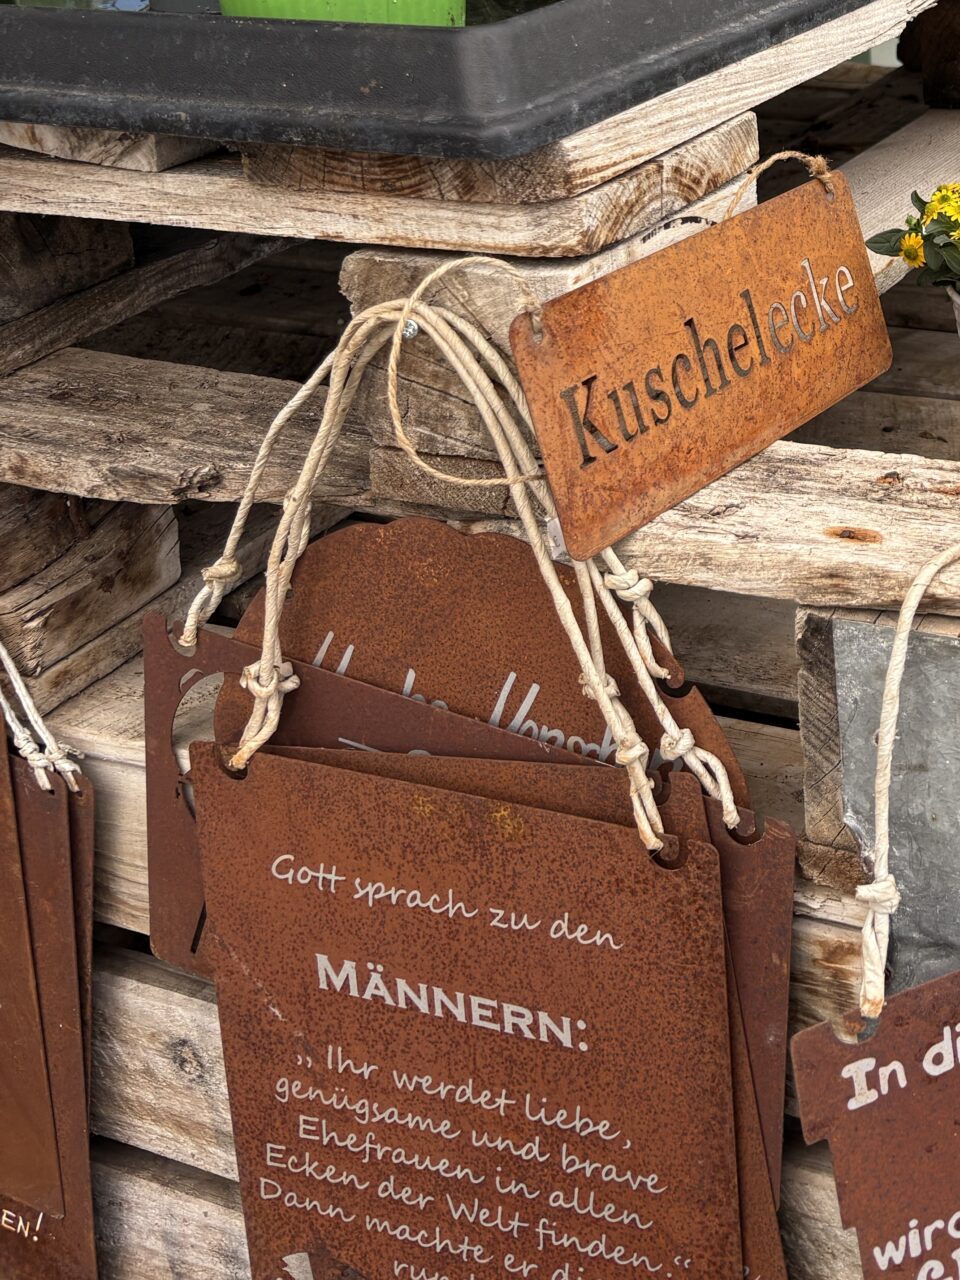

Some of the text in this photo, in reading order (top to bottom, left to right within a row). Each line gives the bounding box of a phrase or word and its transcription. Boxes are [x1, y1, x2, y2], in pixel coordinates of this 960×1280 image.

[560, 257, 860, 470] Kuschelecke
[271, 854, 624, 950] Gott sprach zu den
[315, 954, 590, 1052] MÄNNERN:
[392, 1069, 516, 1112] werdet
[525, 1095, 632, 1150] liebe,
[841, 1058, 908, 1110] In
[275, 1077, 668, 1195] genügsame und brave
[298, 1115, 653, 1230] Ehefrauen in allen
[260, 1178, 356, 1223] Dann
[366, 1214, 494, 1262] machte
[504, 1253, 539, 1277] er
[266, 1143, 370, 1190] Ecken
[377, 1175, 434, 1211] der
[445, 1192, 529, 1235] Welt
